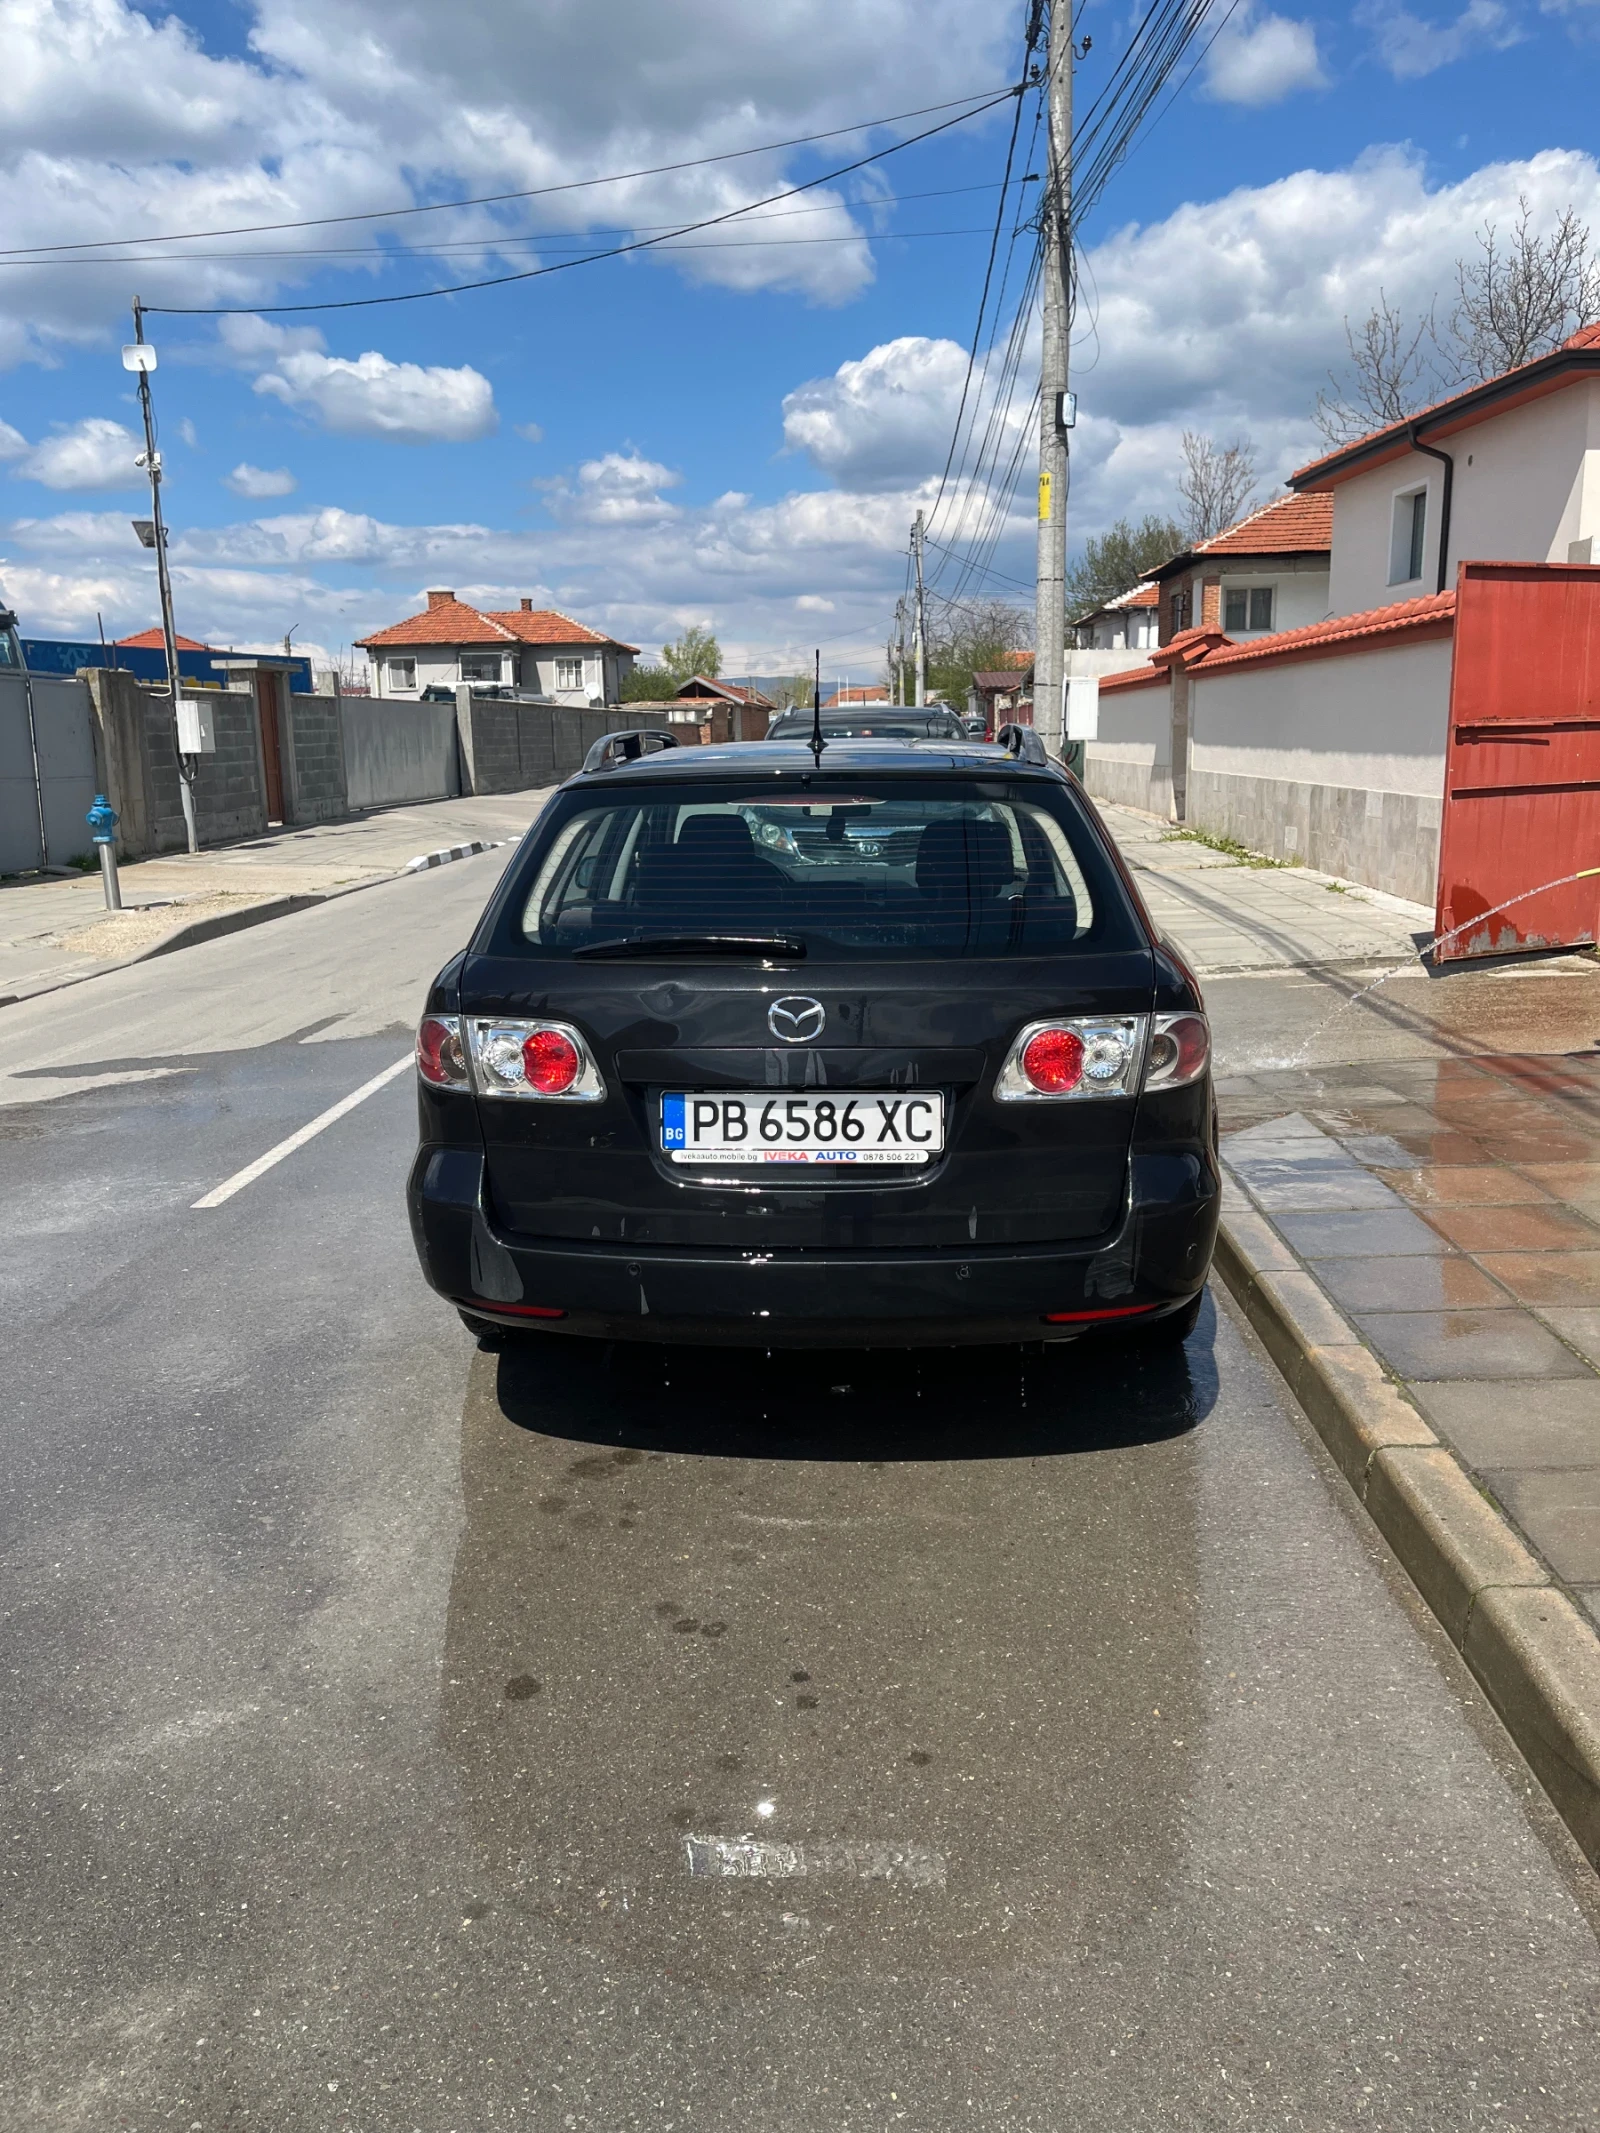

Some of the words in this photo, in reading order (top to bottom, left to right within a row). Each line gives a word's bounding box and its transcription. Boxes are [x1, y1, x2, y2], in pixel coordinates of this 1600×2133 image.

[693, 1100, 748, 1142] PB
[760, 1100, 864, 1142] 6586
[877, 1100, 932, 1142] XC
[666, 1127, 684, 1140] BG
[764, 1151, 808, 1161] IVEKA
[815, 1151, 857, 1161] AUTO
[886, 1153, 903, 1161] 506
